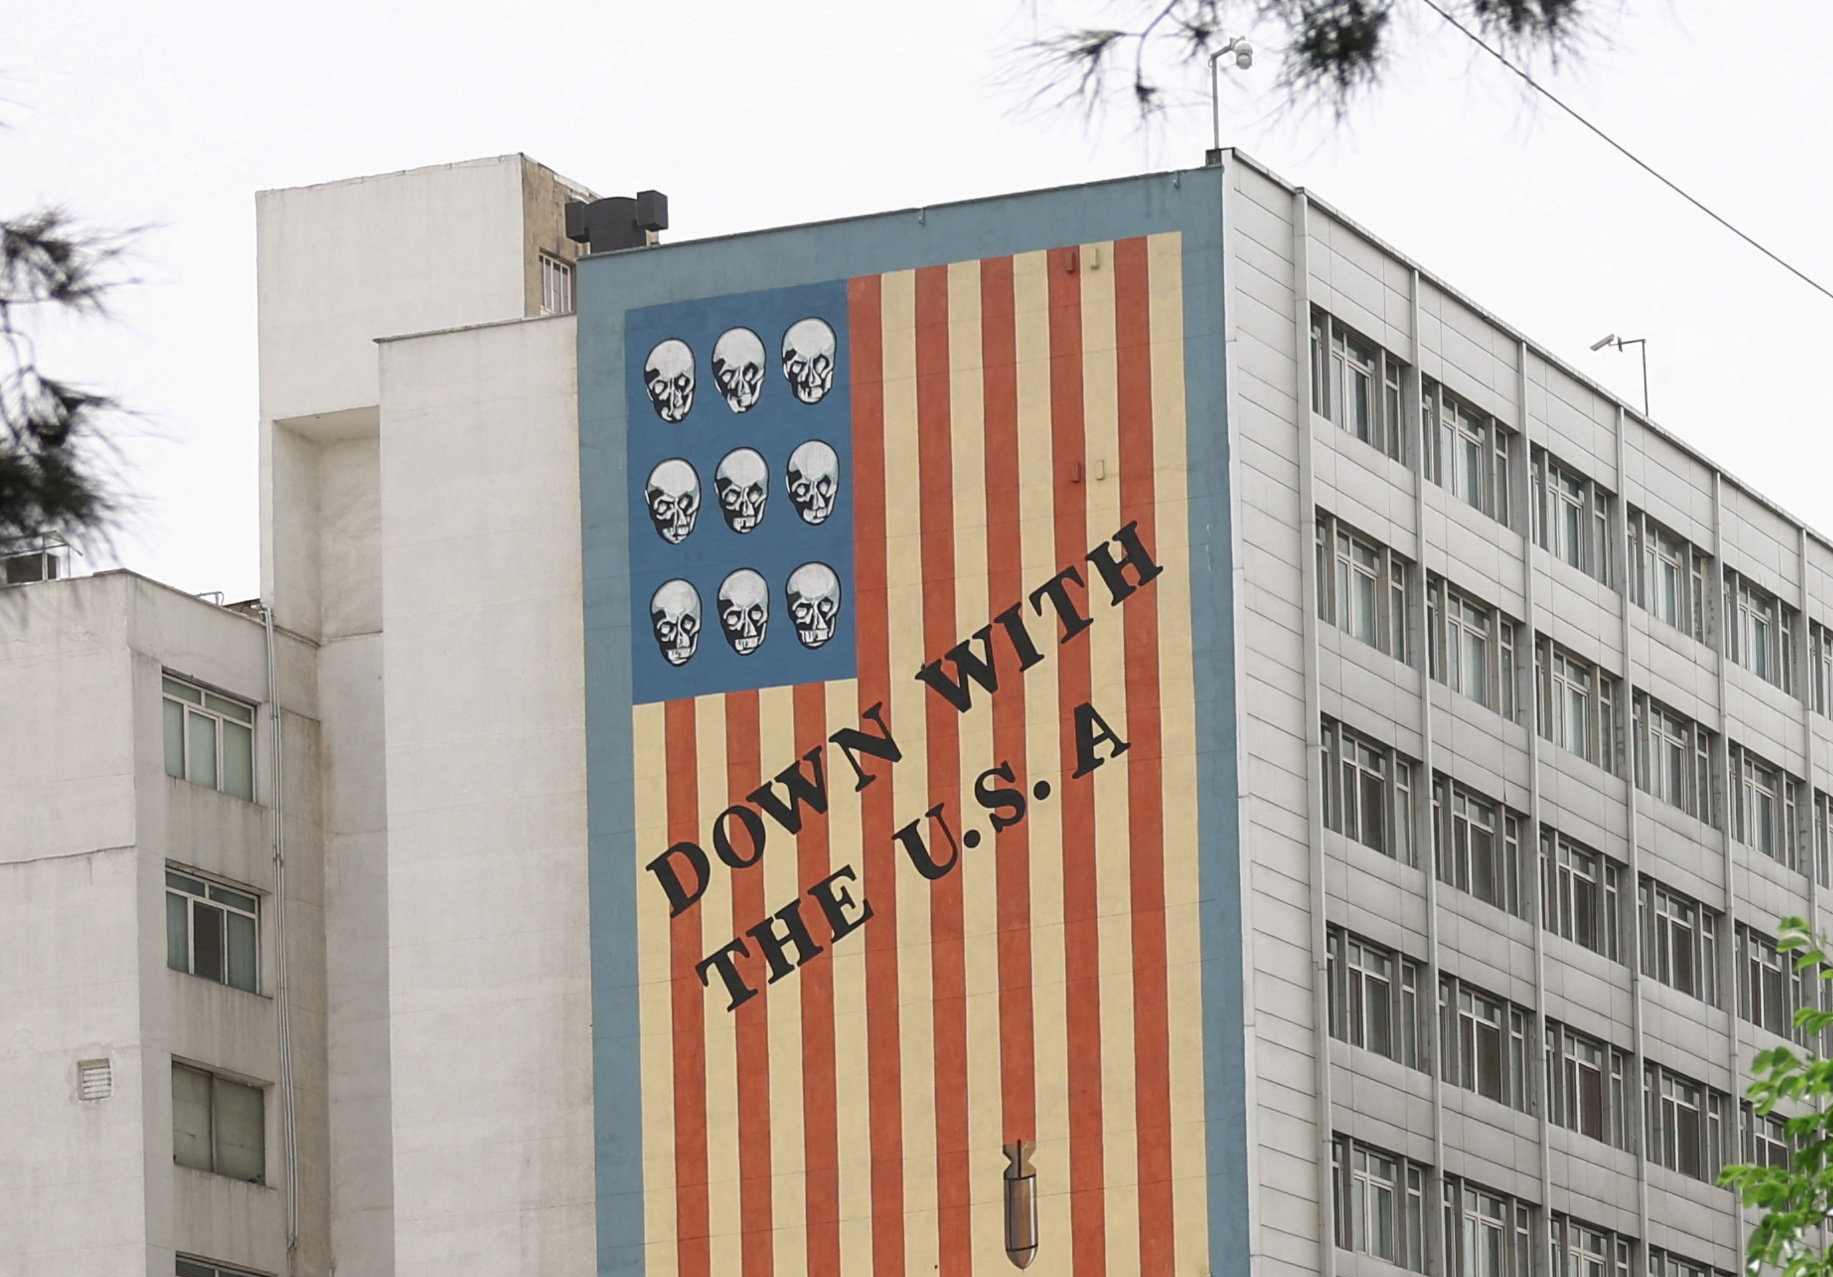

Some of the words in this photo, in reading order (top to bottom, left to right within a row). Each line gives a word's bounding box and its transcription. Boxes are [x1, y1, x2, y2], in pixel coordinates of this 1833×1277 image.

[646, 701, 902, 919] DOWN
[915, 520, 1165, 715] WITH
[696, 865, 874, 1012] THE
